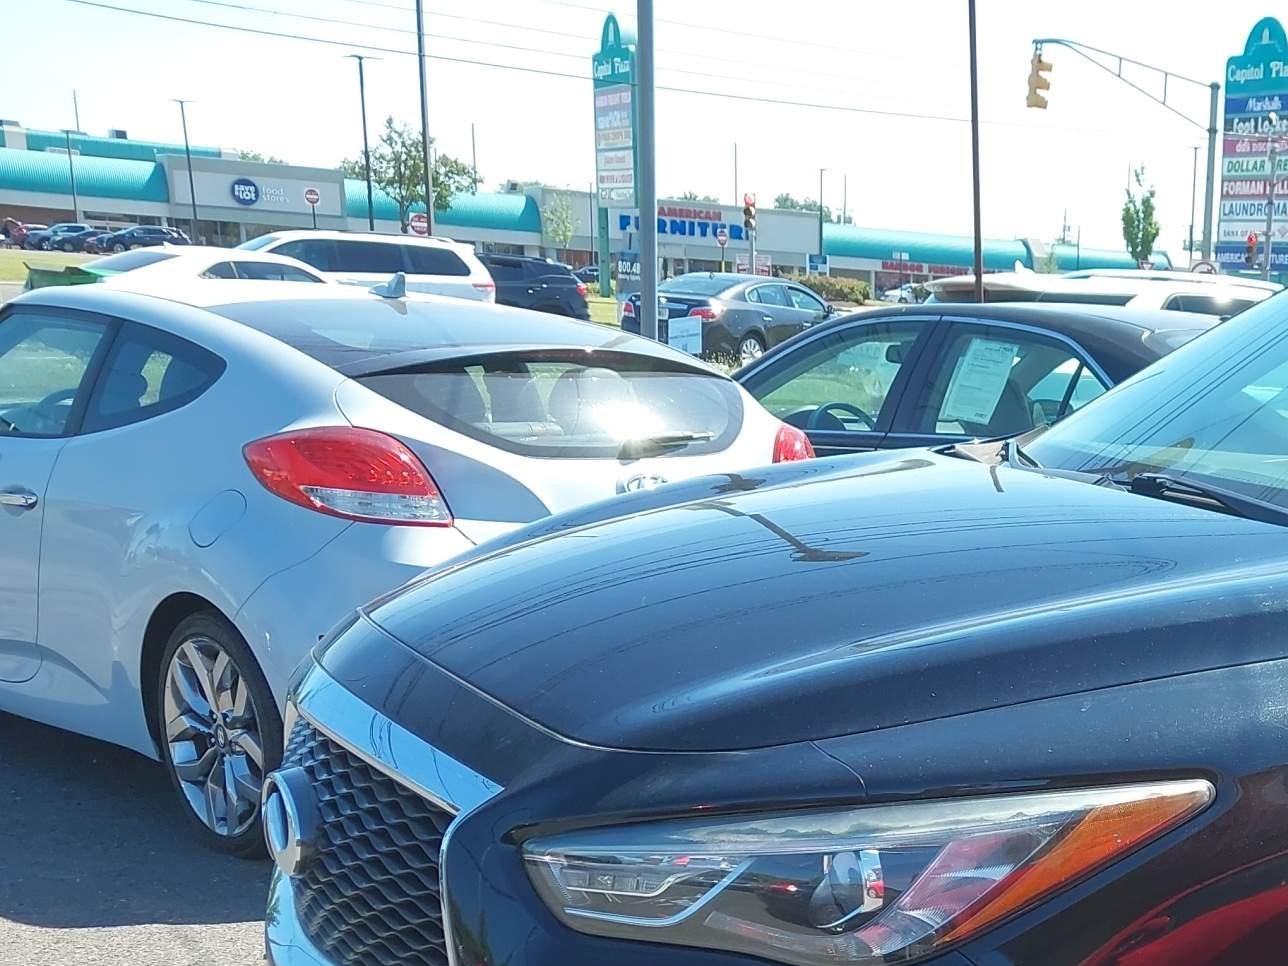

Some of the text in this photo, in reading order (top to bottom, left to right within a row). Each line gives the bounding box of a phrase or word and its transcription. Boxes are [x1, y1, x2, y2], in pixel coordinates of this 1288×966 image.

[1228, 62, 1264, 84] Capitol
[1245, 95, 1282, 112] Marshalls
[1226, 160, 1265, 173] DOLLAR
[1223, 180, 1264, 195] FORMAN
[658, 206, 722, 222] AMERICAN
[1216, 252, 1246, 263] AMERICA
